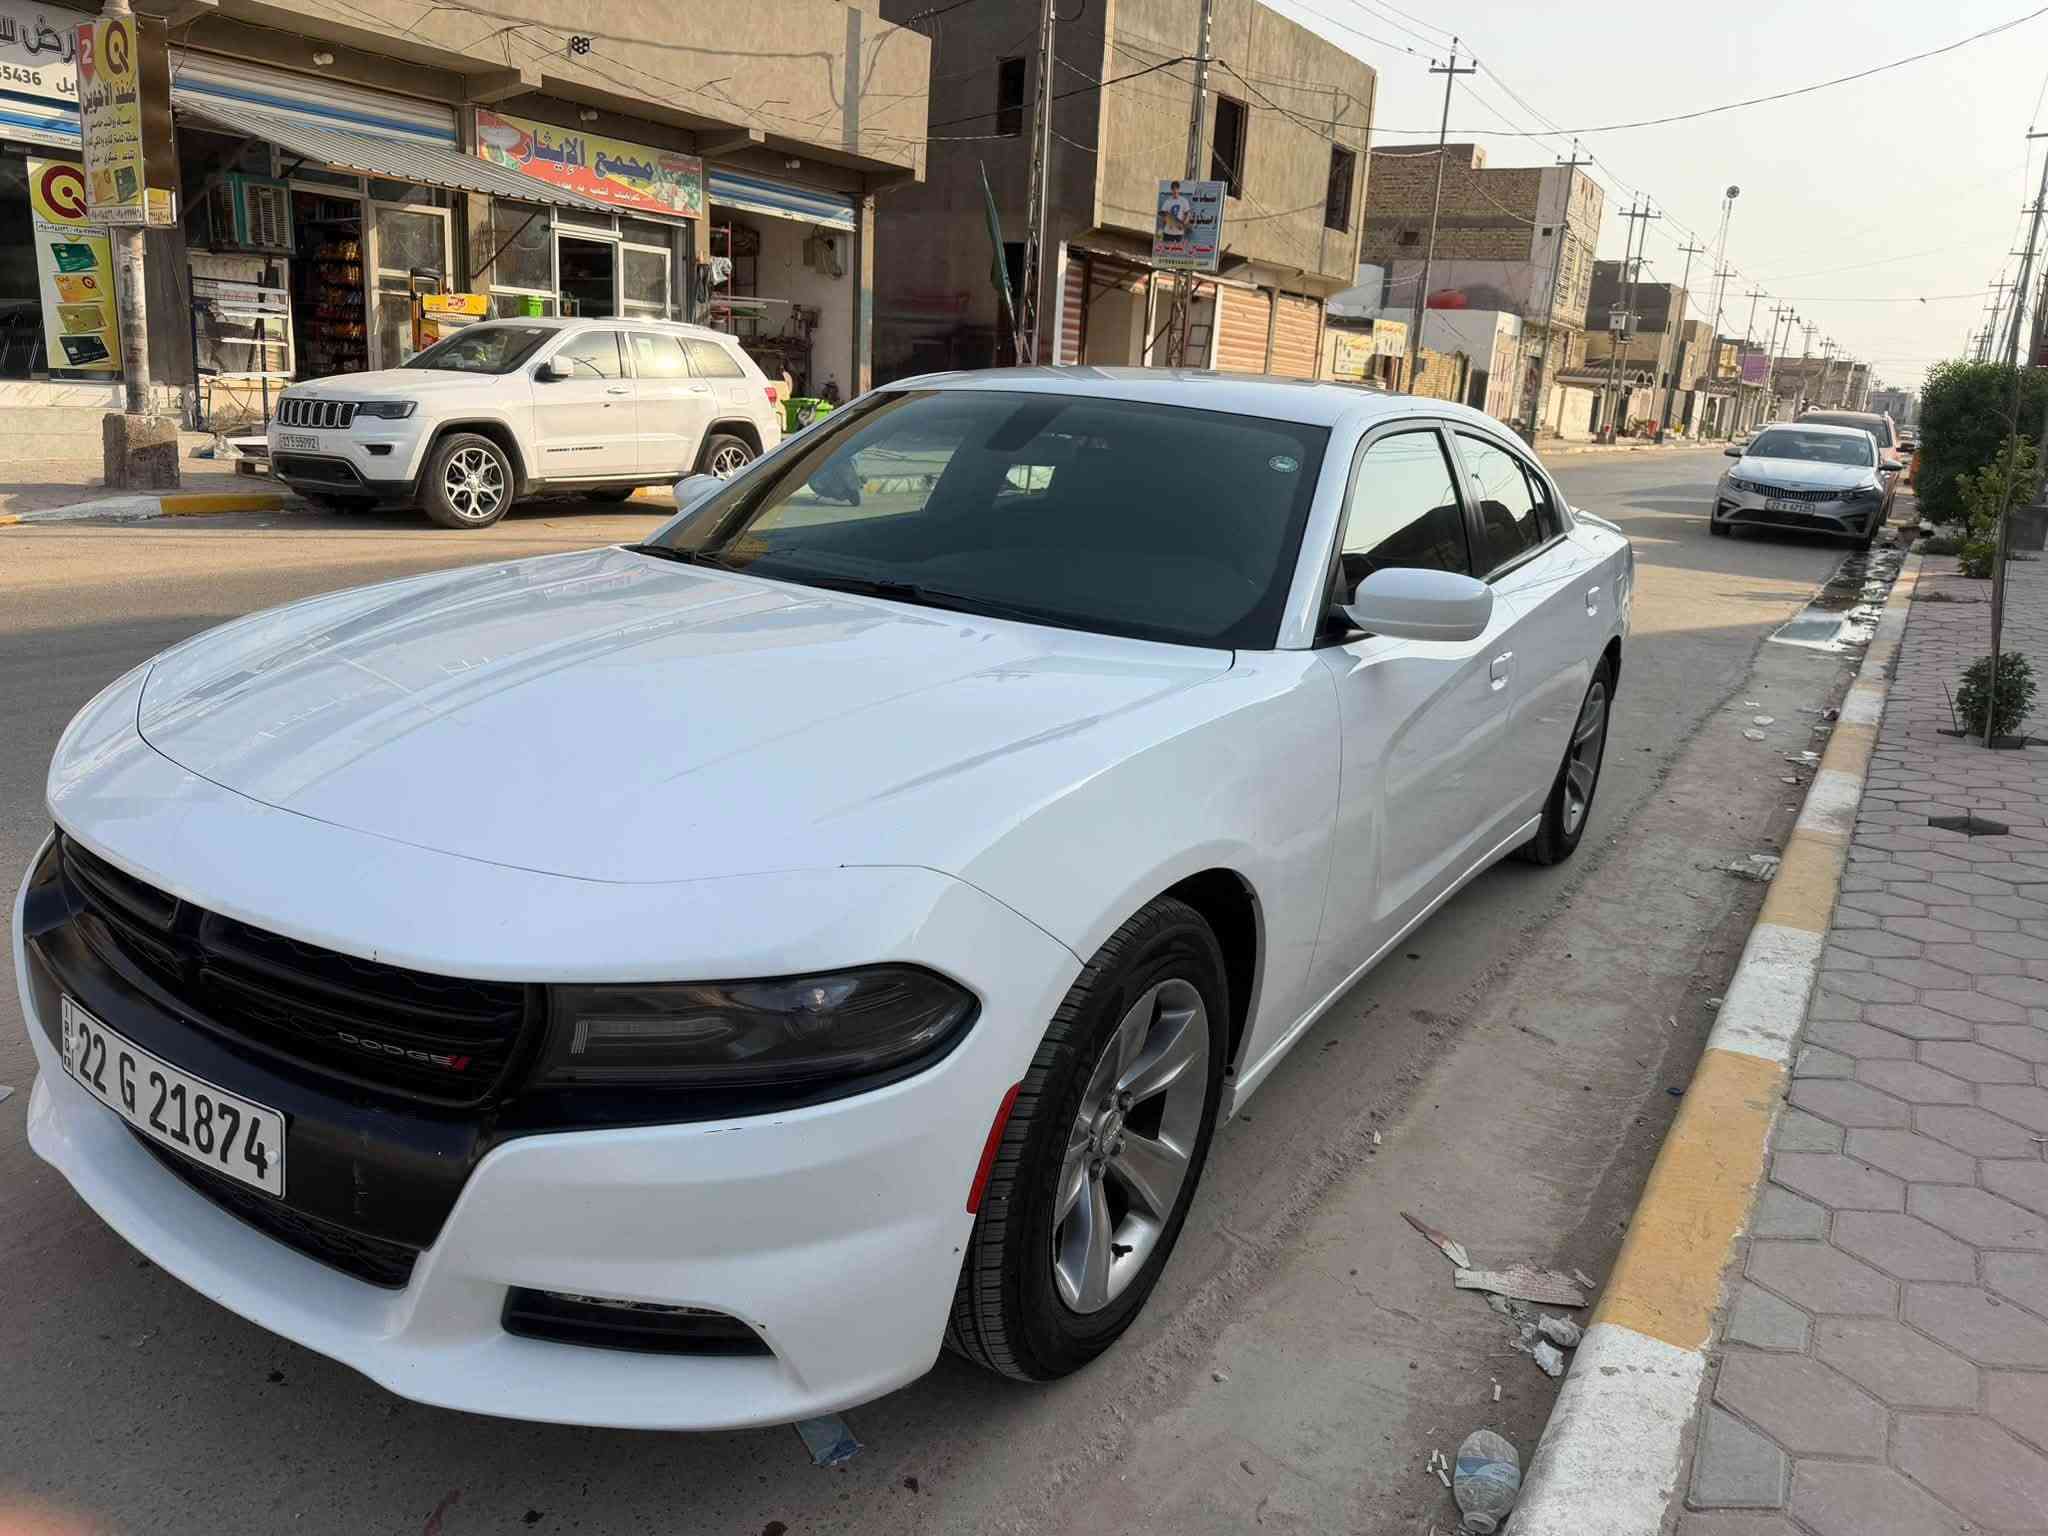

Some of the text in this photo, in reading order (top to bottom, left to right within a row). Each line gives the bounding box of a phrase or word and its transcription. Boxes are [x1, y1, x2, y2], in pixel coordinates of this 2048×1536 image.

[594, 150, 654, 182] مجمع
[337, 1031, 453, 1067] DODGE
[79, 1022, 269, 1179] 22 G 21874
